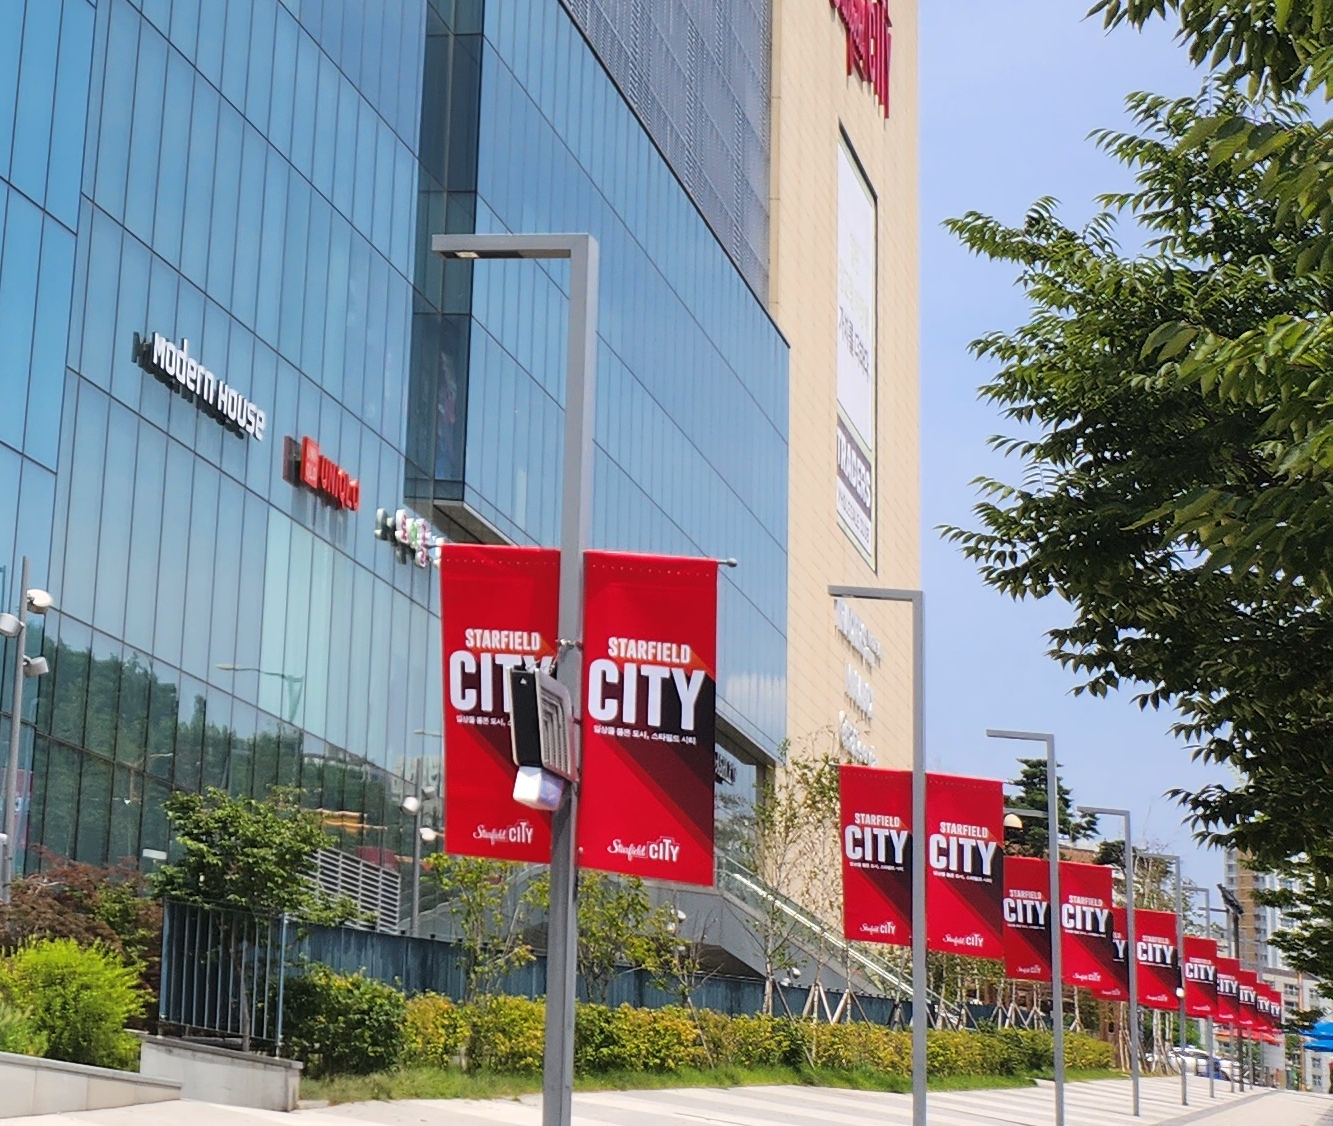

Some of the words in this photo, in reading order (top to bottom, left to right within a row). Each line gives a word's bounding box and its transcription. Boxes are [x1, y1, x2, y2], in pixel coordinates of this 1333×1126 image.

[465, 628, 541, 651] STARFIELD
[608, 637, 691, 664] STARFIELD
[587, 658, 705, 731] CITY
[855, 813, 900, 827] STARFIELD
[939, 822, 988, 838] STARFIELD
[508, 822, 533, 844] CITY
[845, 824, 908, 864] CITY
[649, 839, 680, 862] CITY
[929, 833, 997, 876] CITY
[1003, 898, 1047, 925] CITY
[1061, 903, 1109, 932] CITY
[1137, 941, 1174, 964] CITY
[1185, 963, 1215, 981] CITY
